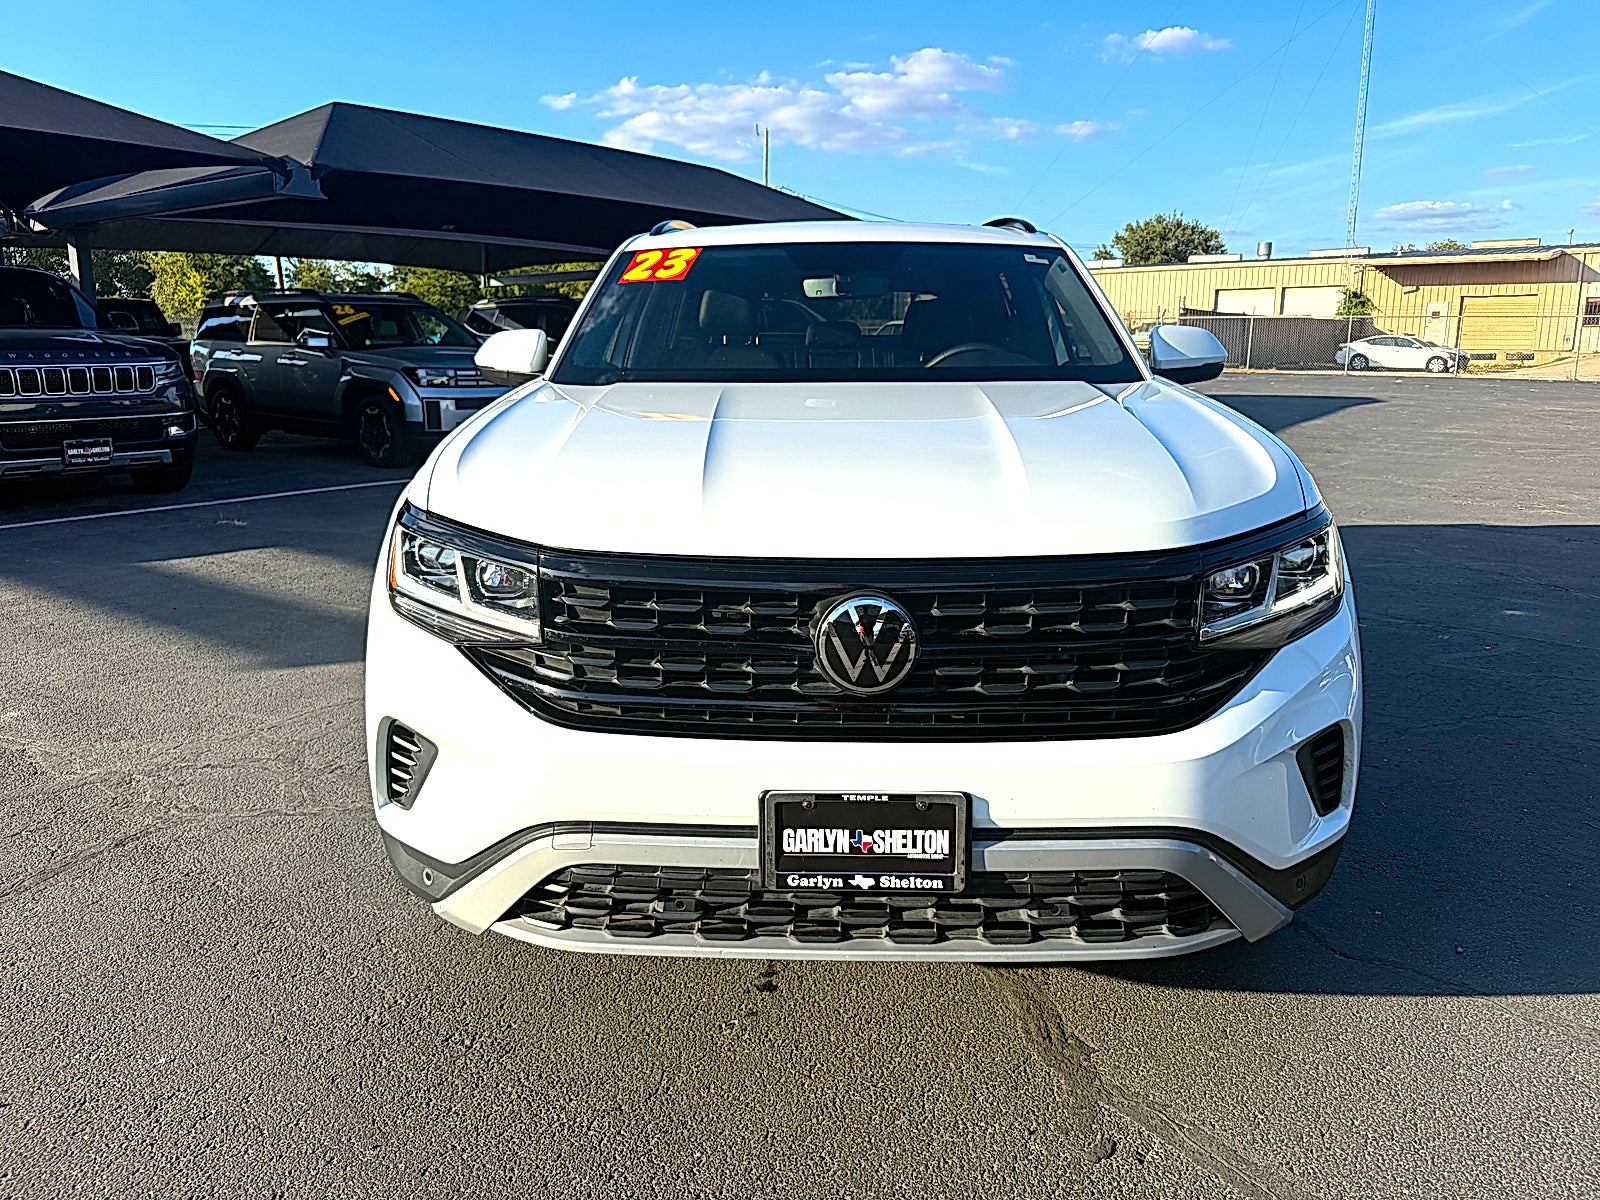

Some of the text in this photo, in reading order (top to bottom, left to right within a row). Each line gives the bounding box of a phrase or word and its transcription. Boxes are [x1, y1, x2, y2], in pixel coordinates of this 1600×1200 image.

[622, 248, 697, 281] 23
[331, 304, 356, 315] 26
[841, 794, 889, 802] TEMPLE
[783, 828, 949, 854] GARLYN SHELTON
[786, 874, 944, 890] Garlyn Shelton
